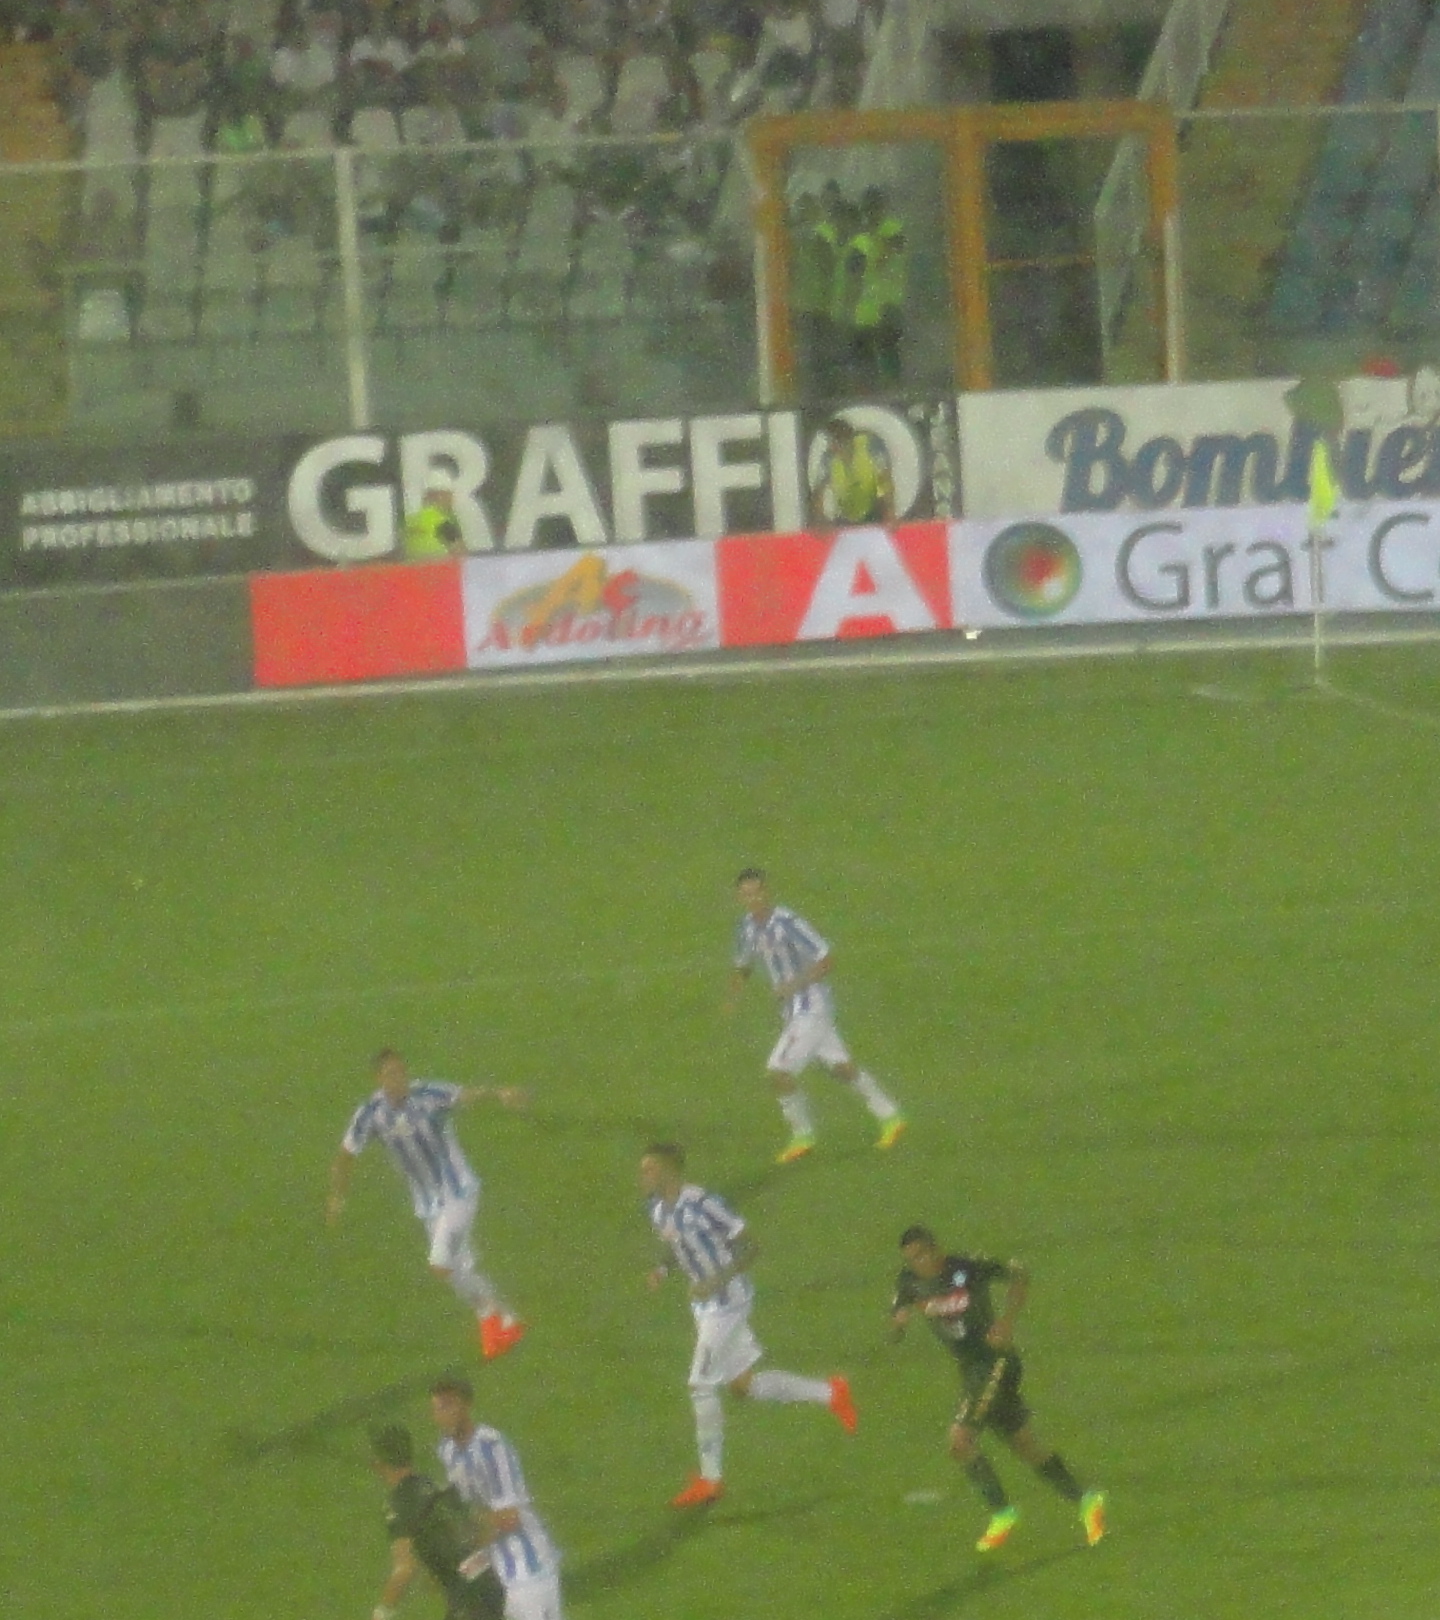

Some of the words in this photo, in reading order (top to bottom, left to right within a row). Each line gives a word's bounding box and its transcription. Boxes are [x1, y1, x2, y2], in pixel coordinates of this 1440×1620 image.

[21, 511, 254, 552] PROFESSIONALE
[287, 403, 920, 562] GRAFFIO
[796, 527, 938, 641] A
